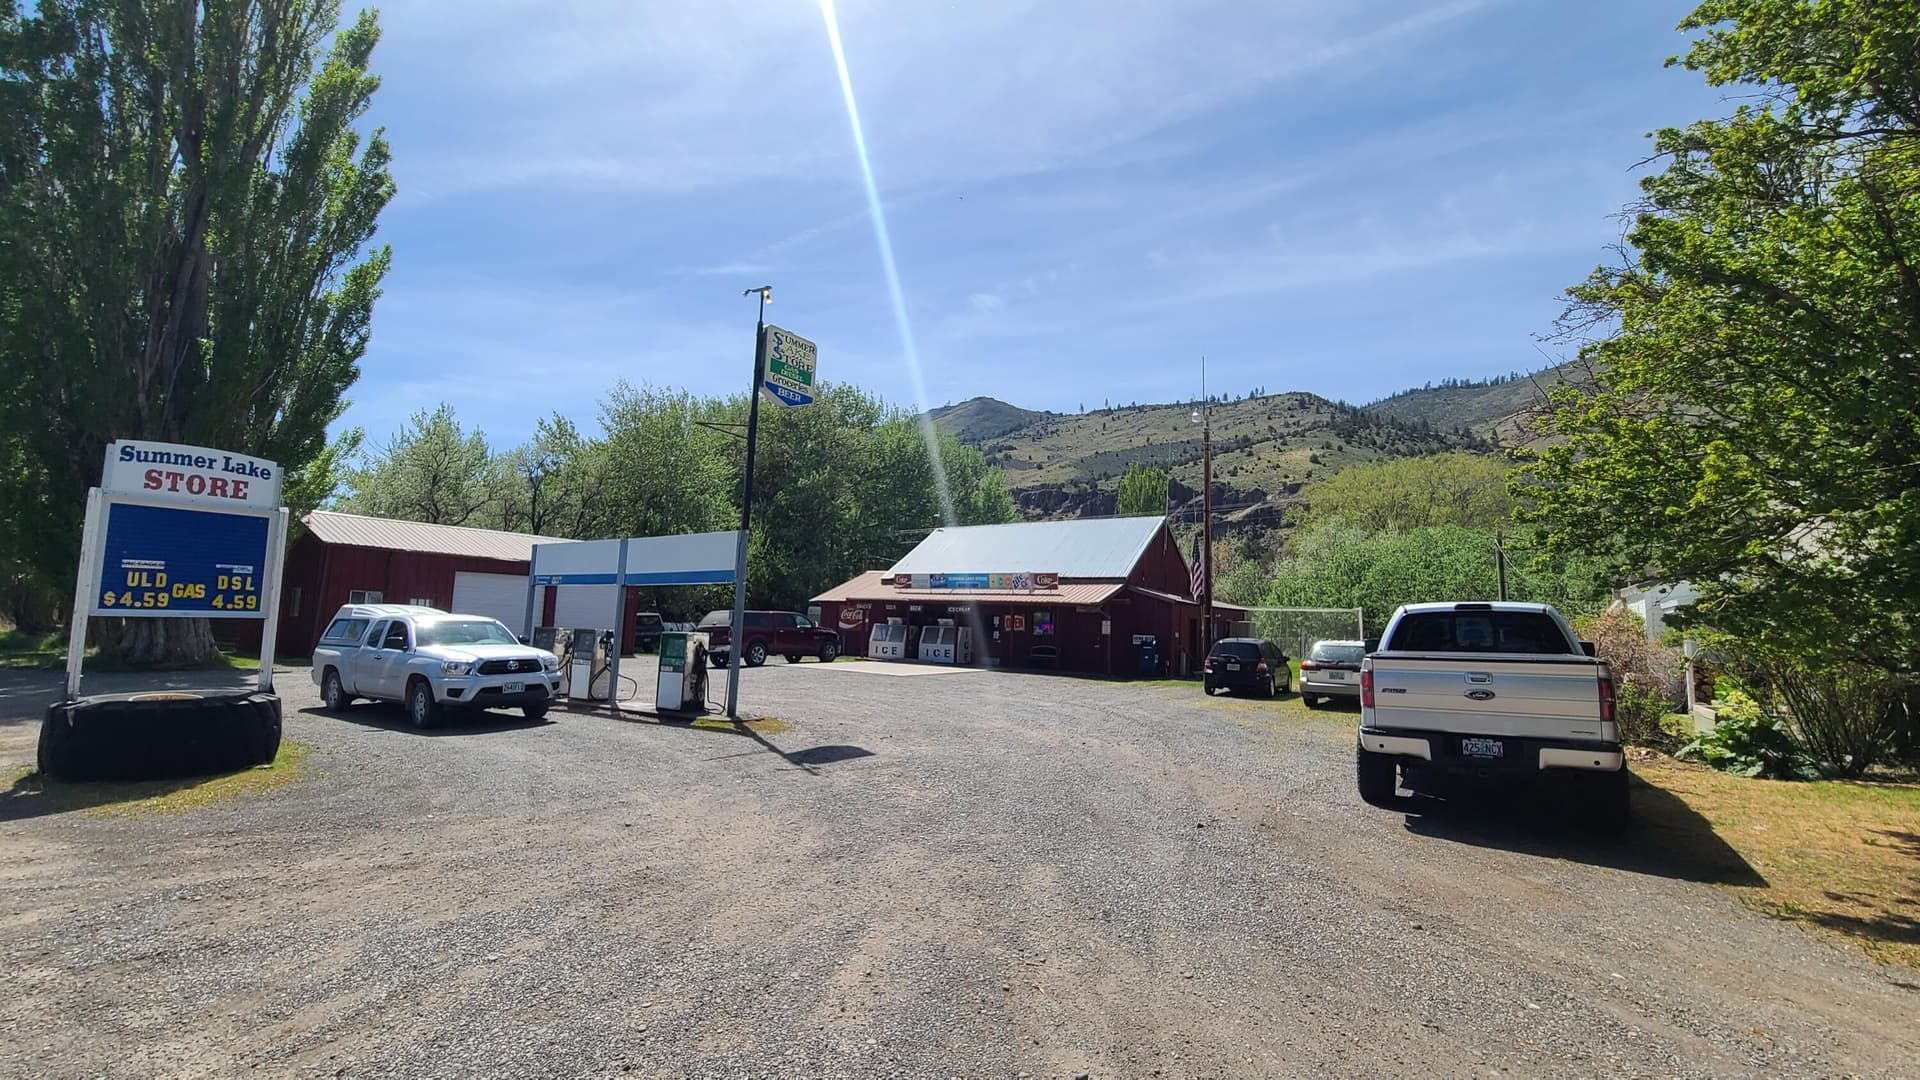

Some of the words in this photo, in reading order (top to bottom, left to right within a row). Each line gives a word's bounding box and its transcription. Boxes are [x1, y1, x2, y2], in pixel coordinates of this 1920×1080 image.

[773, 331, 815, 354] SUMMER
[772, 346, 814, 374] STORE
[777, 387, 801, 402] BEER
[119, 445, 217, 470] Summer
[221, 456, 272, 480] Lake
[143, 469, 249, 500] STORE
[126, 571, 167, 588] ULD
[217, 575, 255, 591] DSL
[171, 583, 206, 599] GAS
[103, 591, 169, 608] $4.59
[211, 594, 257, 610] 4.59
[874, 646, 898, 655] ICE
[925, 649, 952, 658] ICE
[1463, 742, 1480, 753] 425
